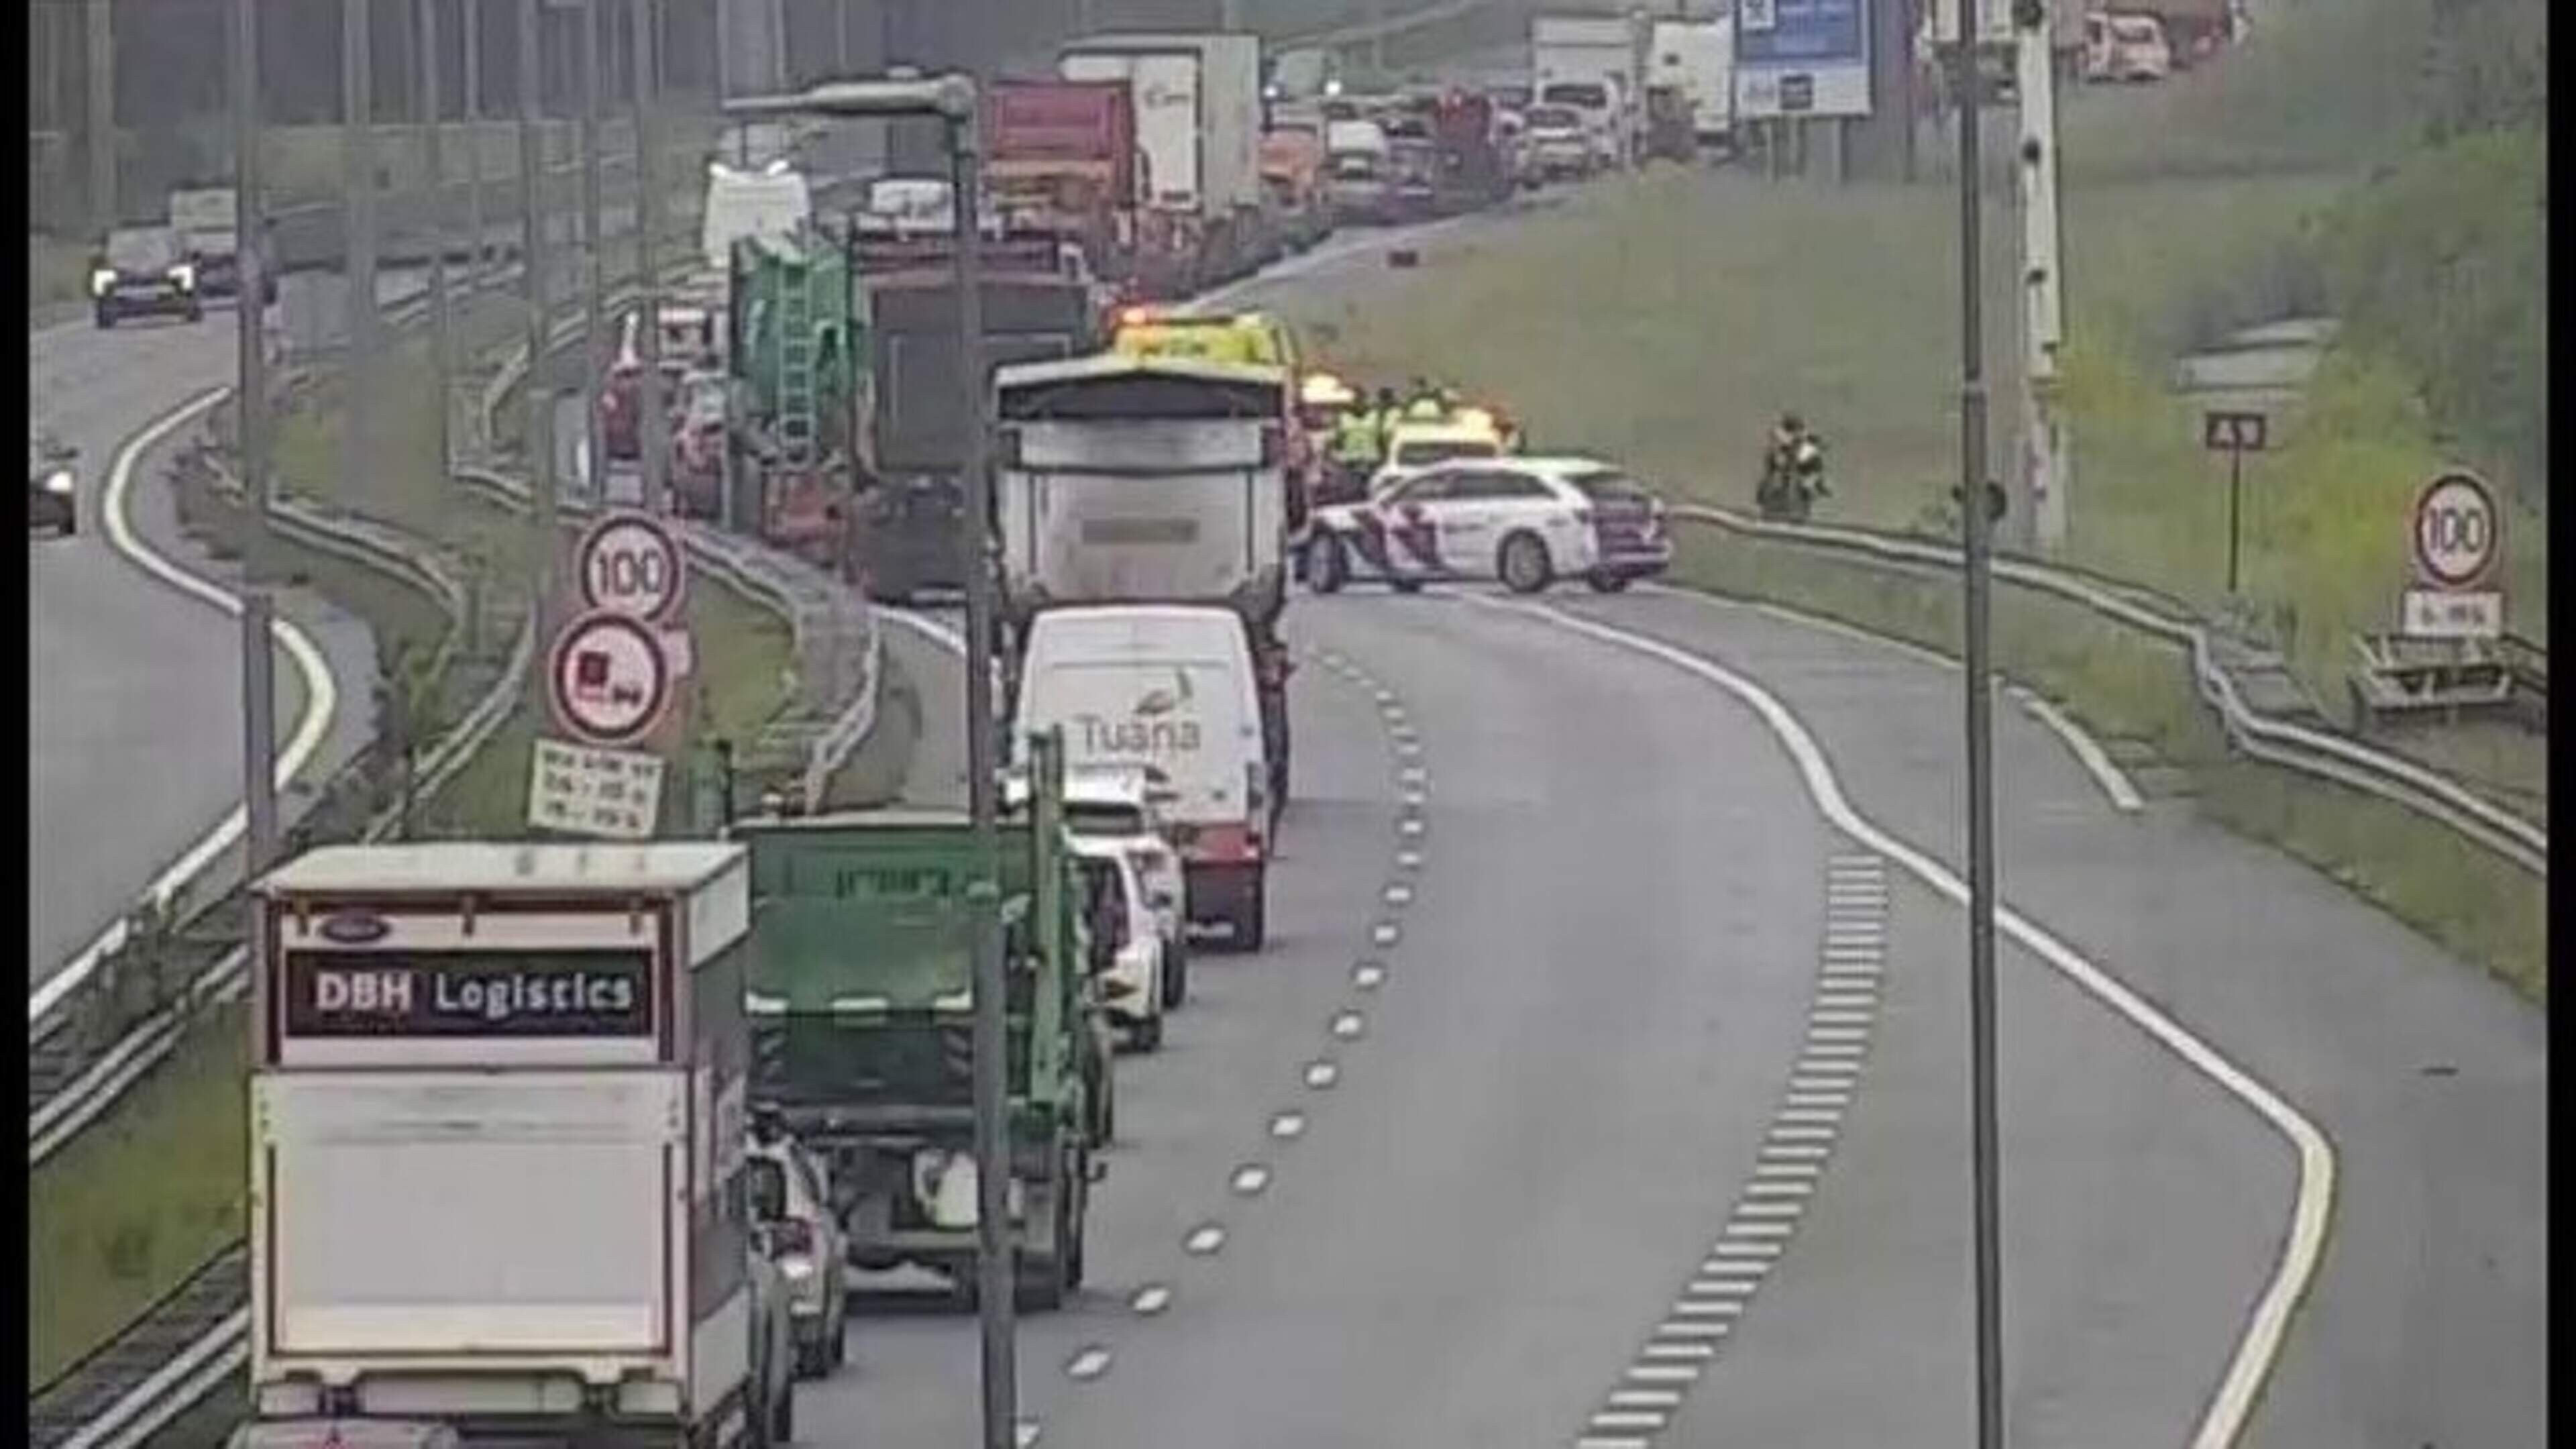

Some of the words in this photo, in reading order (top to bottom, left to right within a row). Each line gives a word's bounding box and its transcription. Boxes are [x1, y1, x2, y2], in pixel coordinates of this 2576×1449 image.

[2429, 508, 2483, 551] 100
[596, 551, 664, 596] 100
[1075, 715, 1199, 753] Tuana
[317, 971, 411, 1009] DBH
[436, 971, 631, 1018] Logistics
